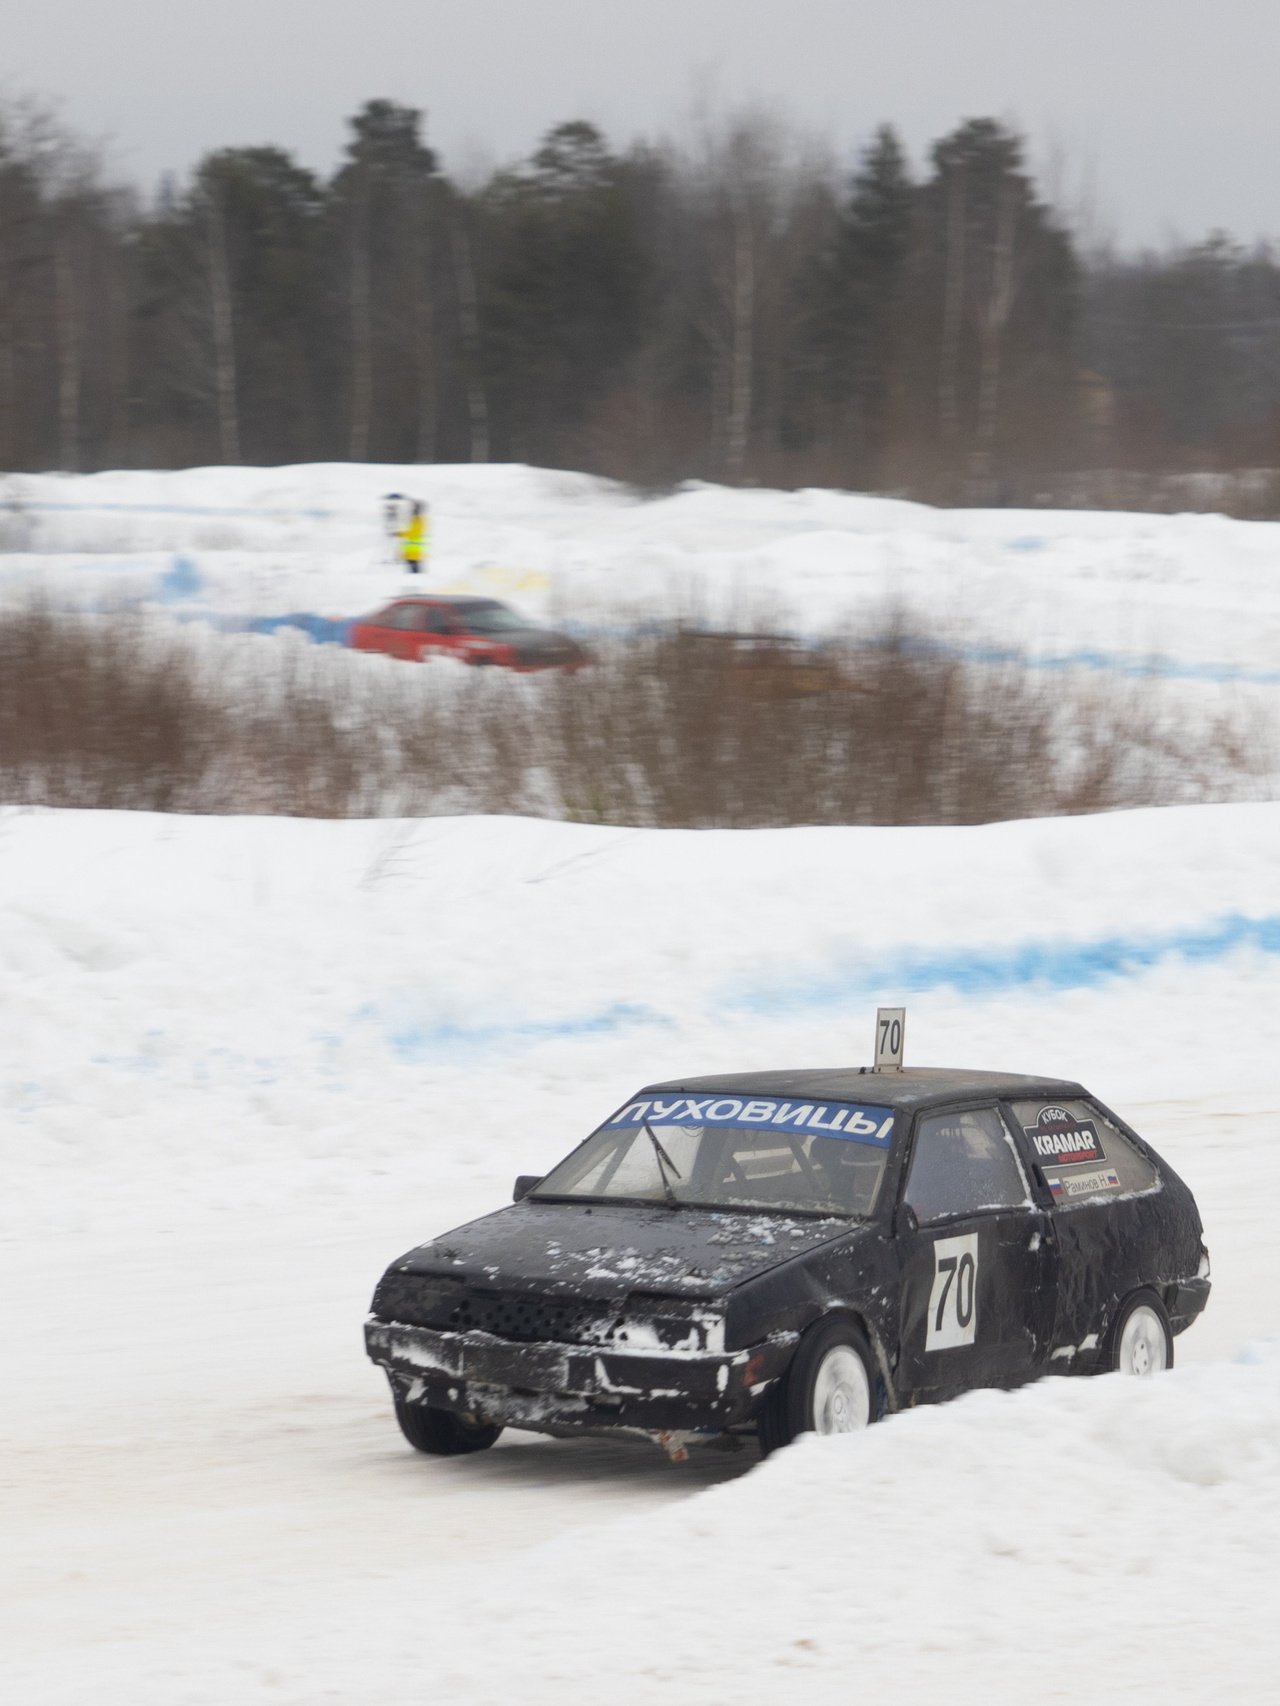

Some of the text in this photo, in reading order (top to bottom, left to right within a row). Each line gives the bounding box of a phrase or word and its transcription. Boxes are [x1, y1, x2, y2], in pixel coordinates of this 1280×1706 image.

[880, 1019, 901, 1055] 70
[610, 1099, 895, 1140] ЛУХОВИЦЫ
[1041, 1108, 1069, 1125] КУБОК
[1032, 1130, 1096, 1155] KRAMAR
[935, 1252, 975, 1332] 70
